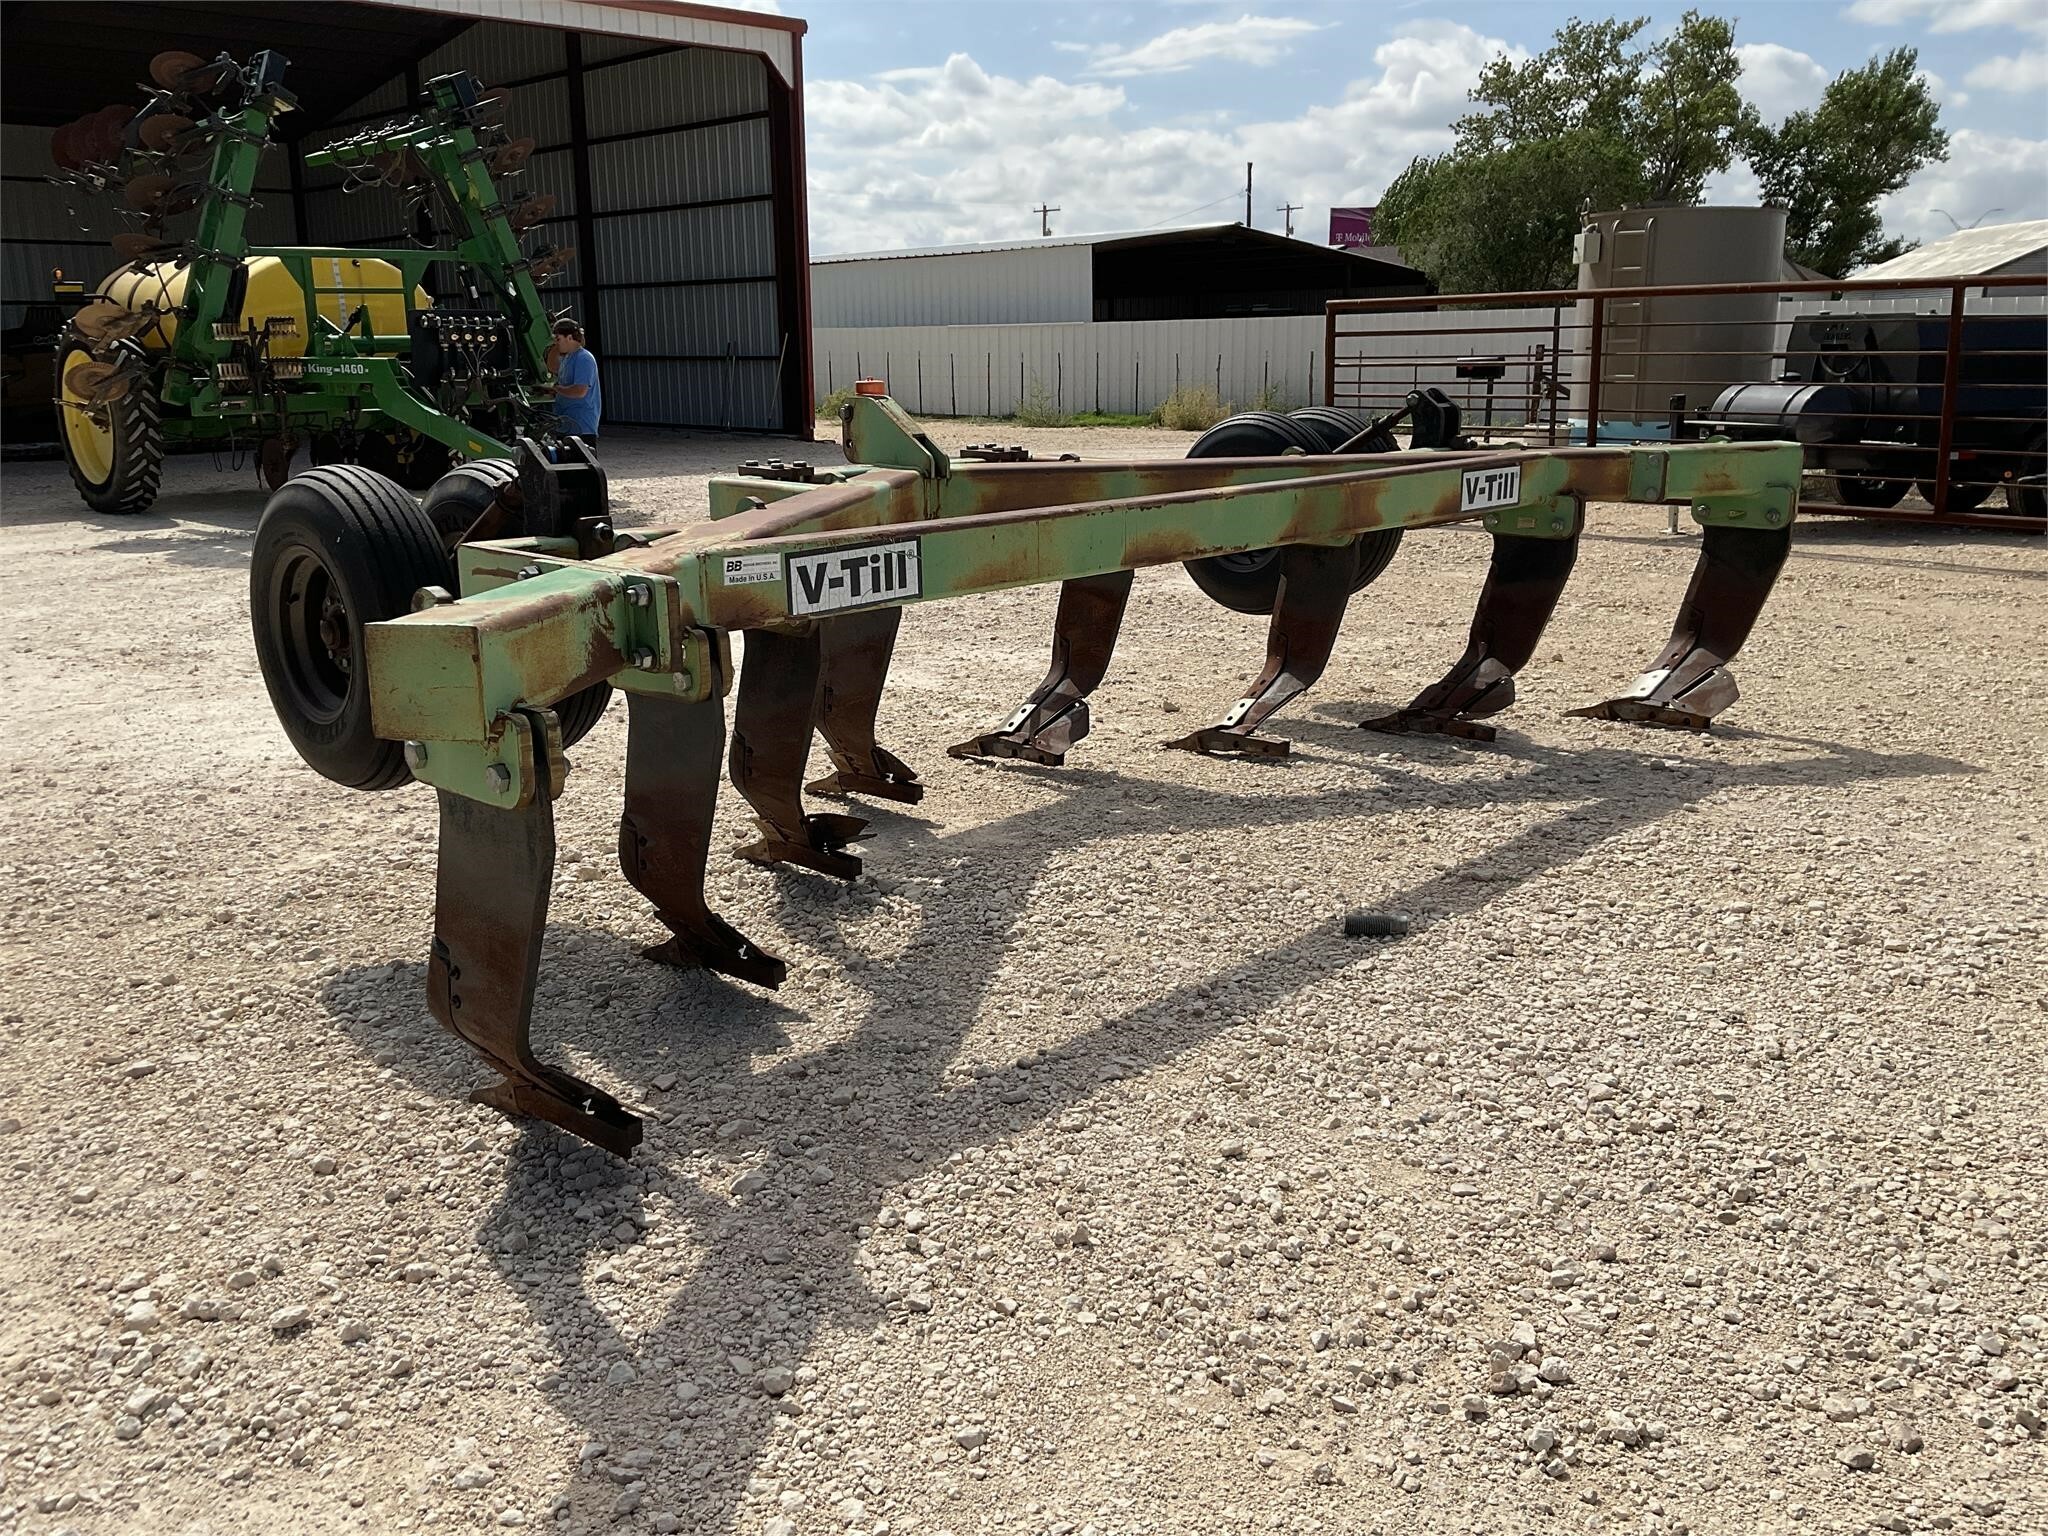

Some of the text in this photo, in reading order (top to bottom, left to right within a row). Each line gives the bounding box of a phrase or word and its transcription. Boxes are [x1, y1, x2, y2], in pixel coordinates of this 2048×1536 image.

[1465, 472, 1515, 505] V-Till
[726, 560, 743, 572] BB
[796, 549, 907, 604] V-Till
